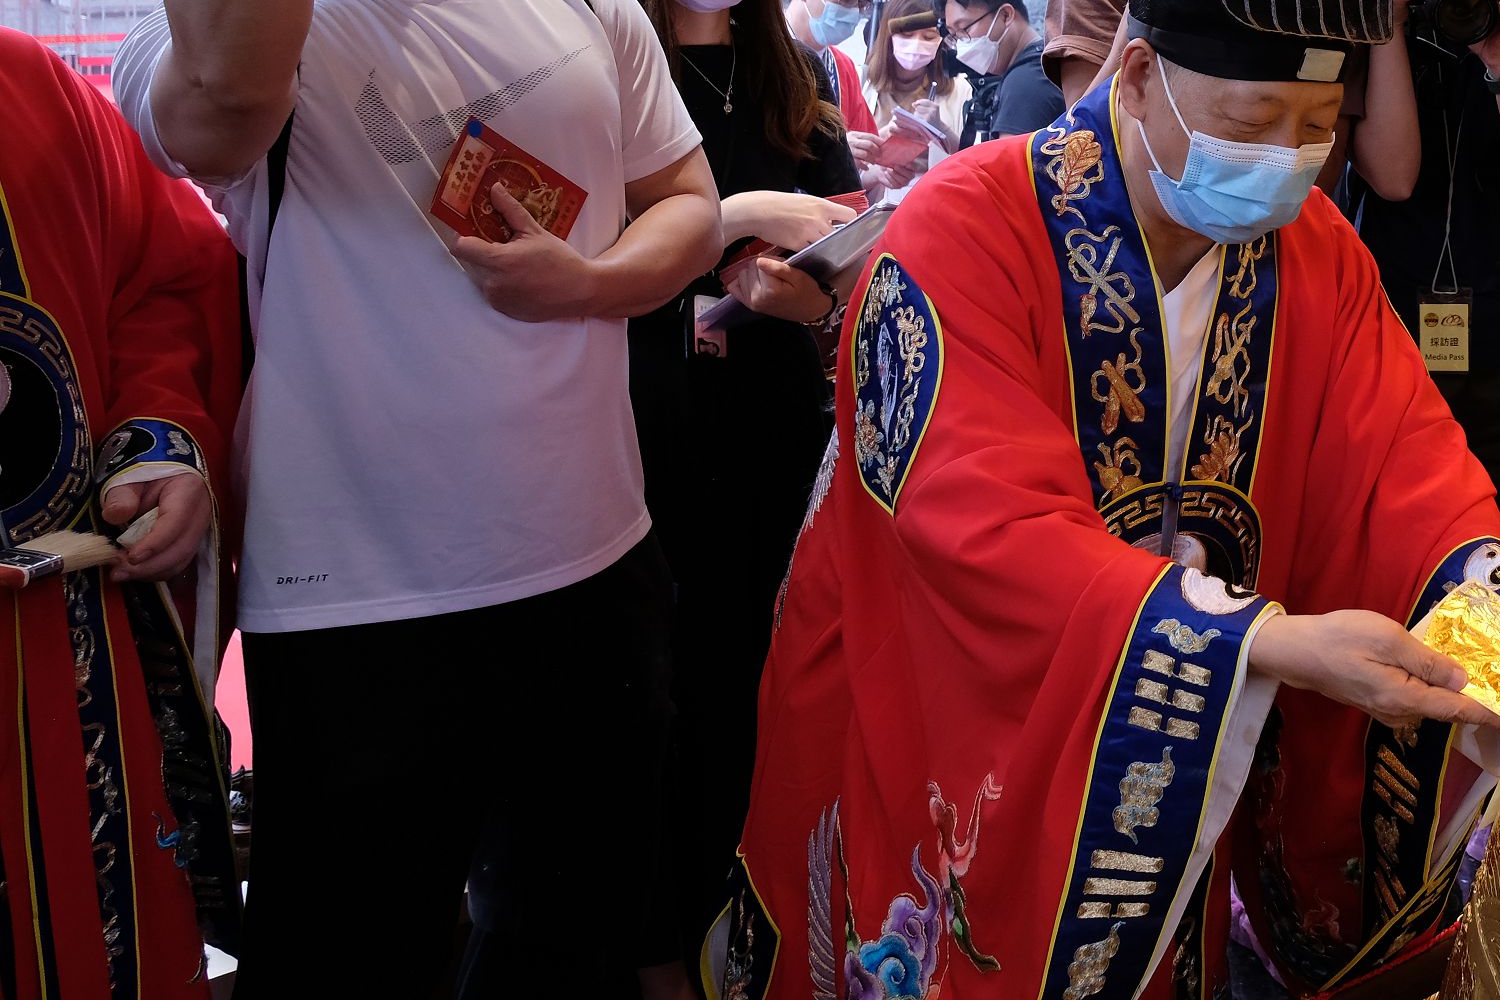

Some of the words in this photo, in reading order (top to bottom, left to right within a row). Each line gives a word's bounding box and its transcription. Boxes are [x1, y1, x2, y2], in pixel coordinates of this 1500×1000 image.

[1430, 337, 1459, 347] 採訪證
[276, 573, 329, 585] DRI-FIT
